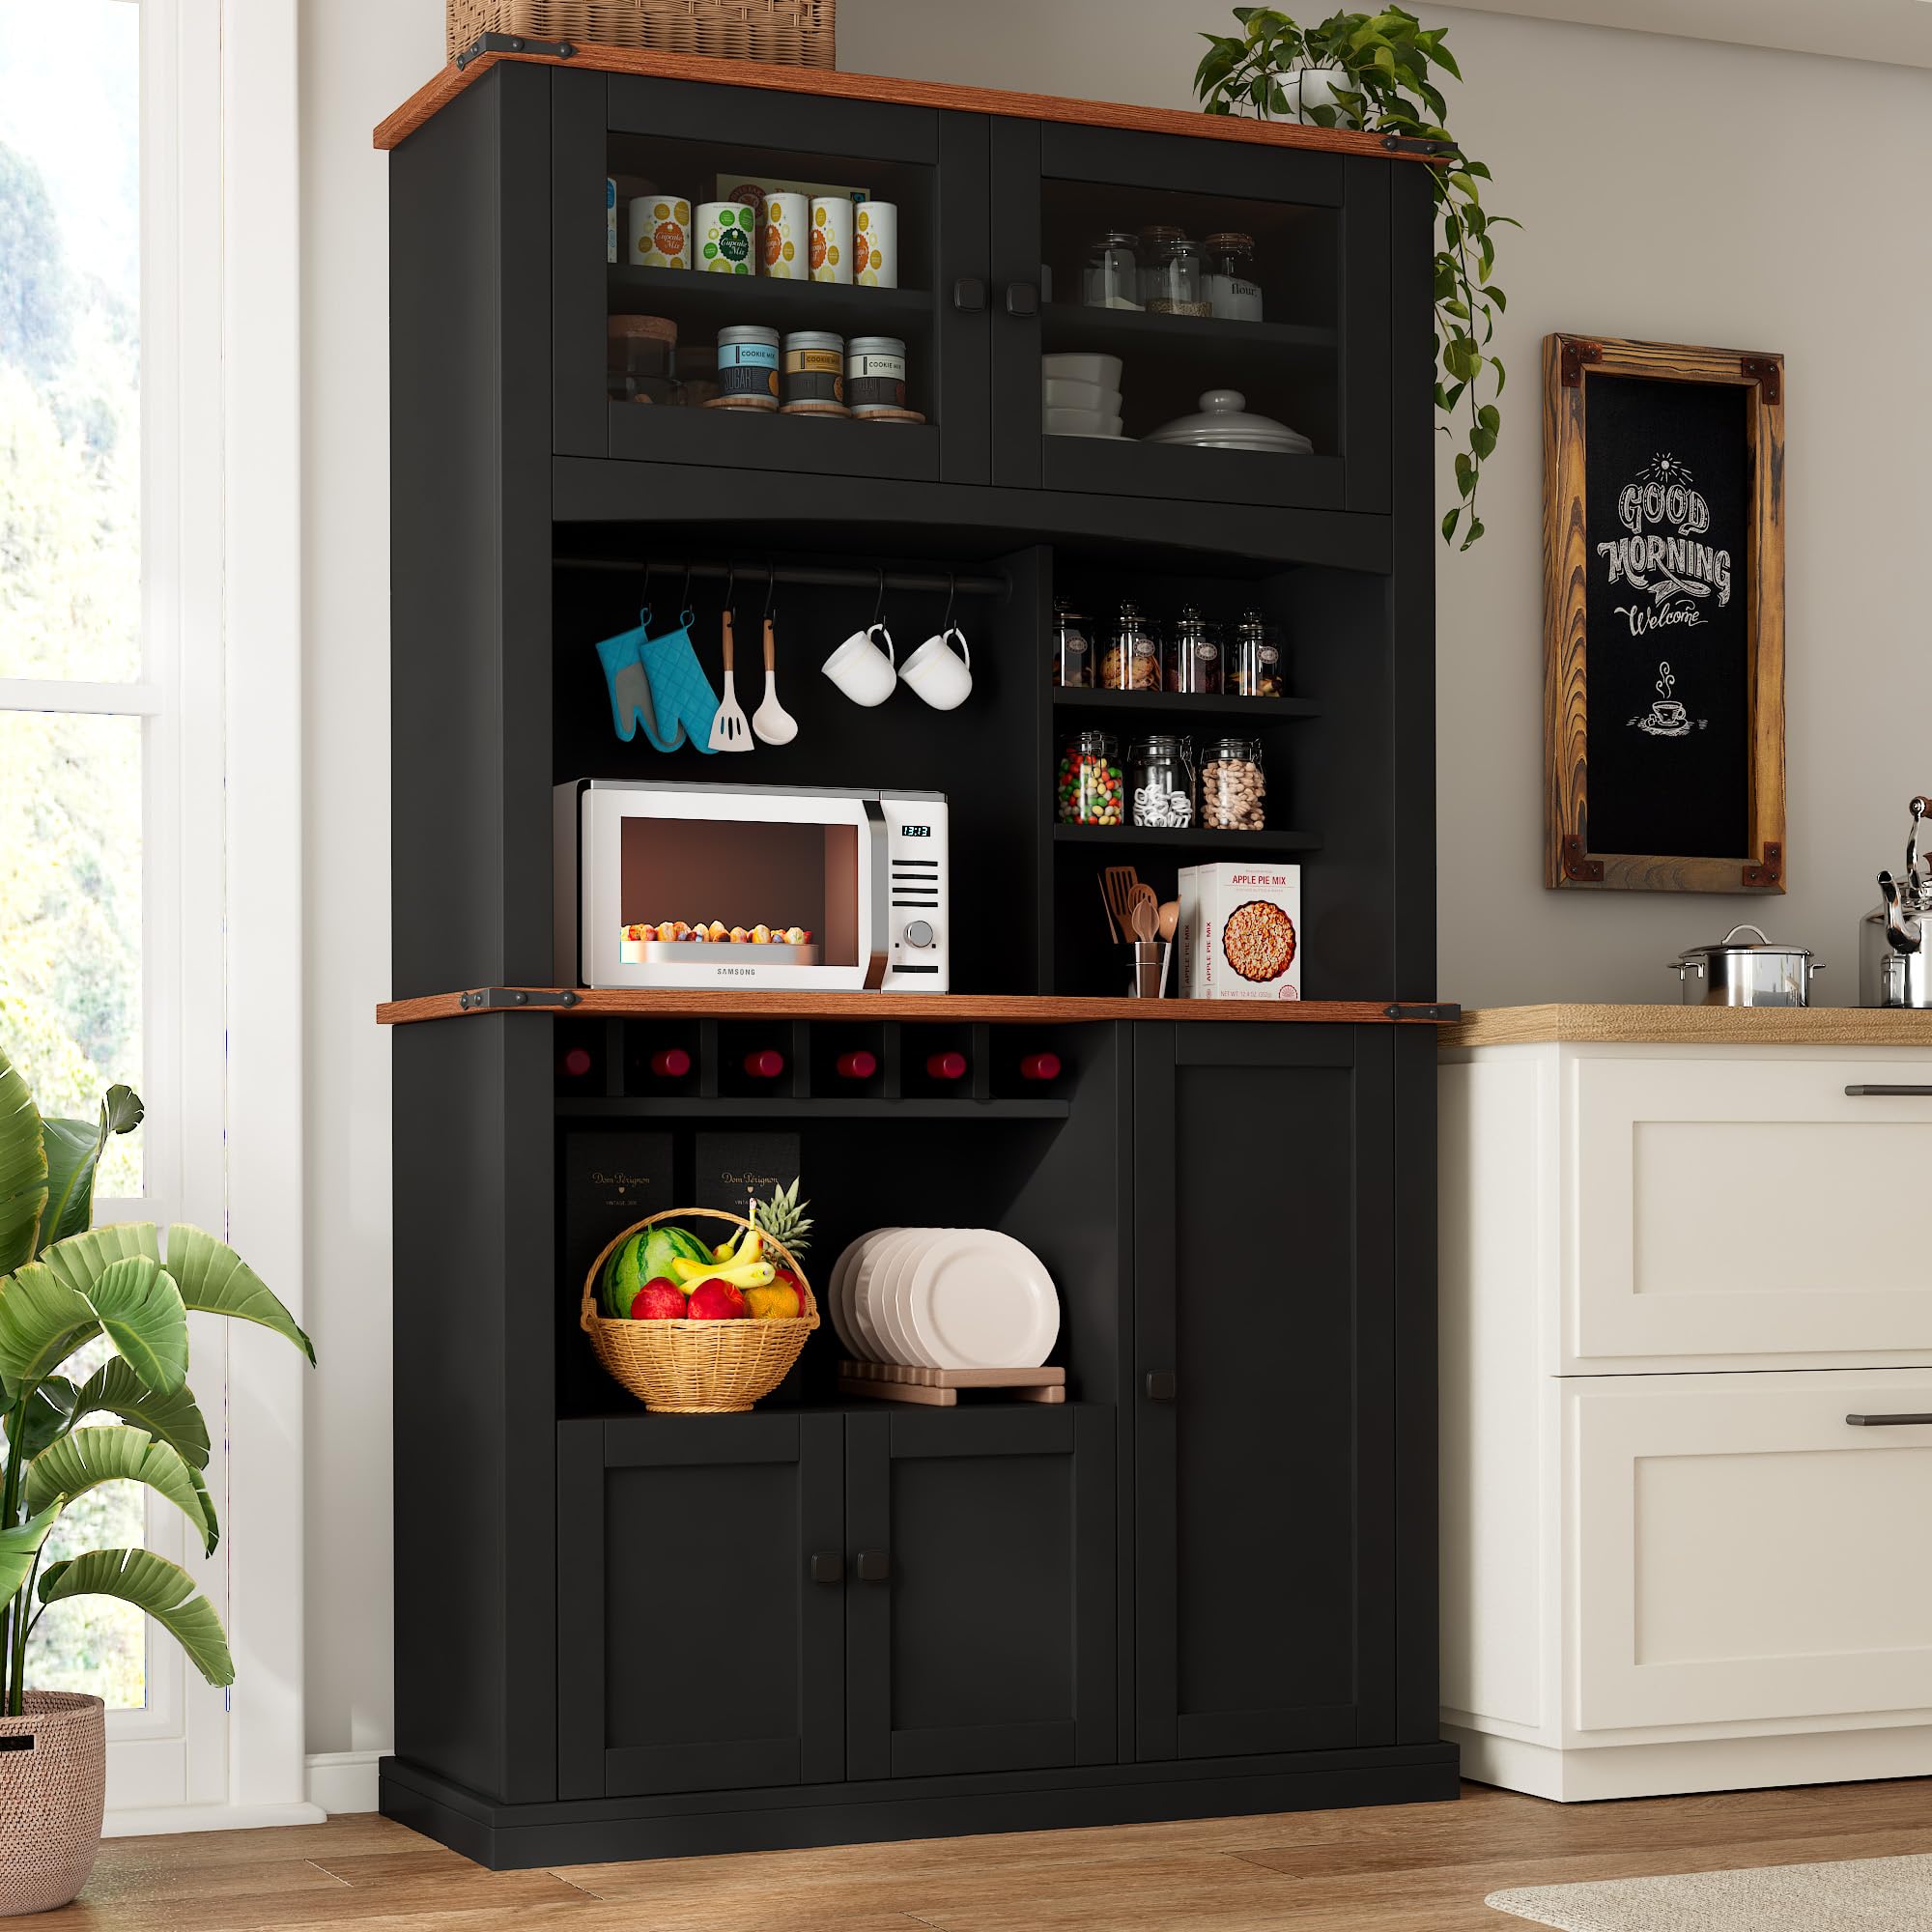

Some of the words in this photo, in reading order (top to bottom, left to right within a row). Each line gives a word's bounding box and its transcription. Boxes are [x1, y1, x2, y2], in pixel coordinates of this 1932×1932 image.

[721, 237, 748, 247] Cupcake
[806, 355, 832, 364] COOKIE
[868, 360, 893, 369] COOKIE
[724, 368, 752, 391] SUGAR
[1618, 481, 1710, 535] GOOD
[1597, 534, 1731, 608] MORNING
[1613, 599, 1709, 637] Welcome
[903, 826, 927, 837] 13:13
[1232, 874, 1256, 884] APPLE
[1259, 875, 1269, 885] PIE
[1272, 876, 1286, 886] MIX
[592, 1172, 613, 1184] Dom
[721, 1172, 743, 1183] Dom
